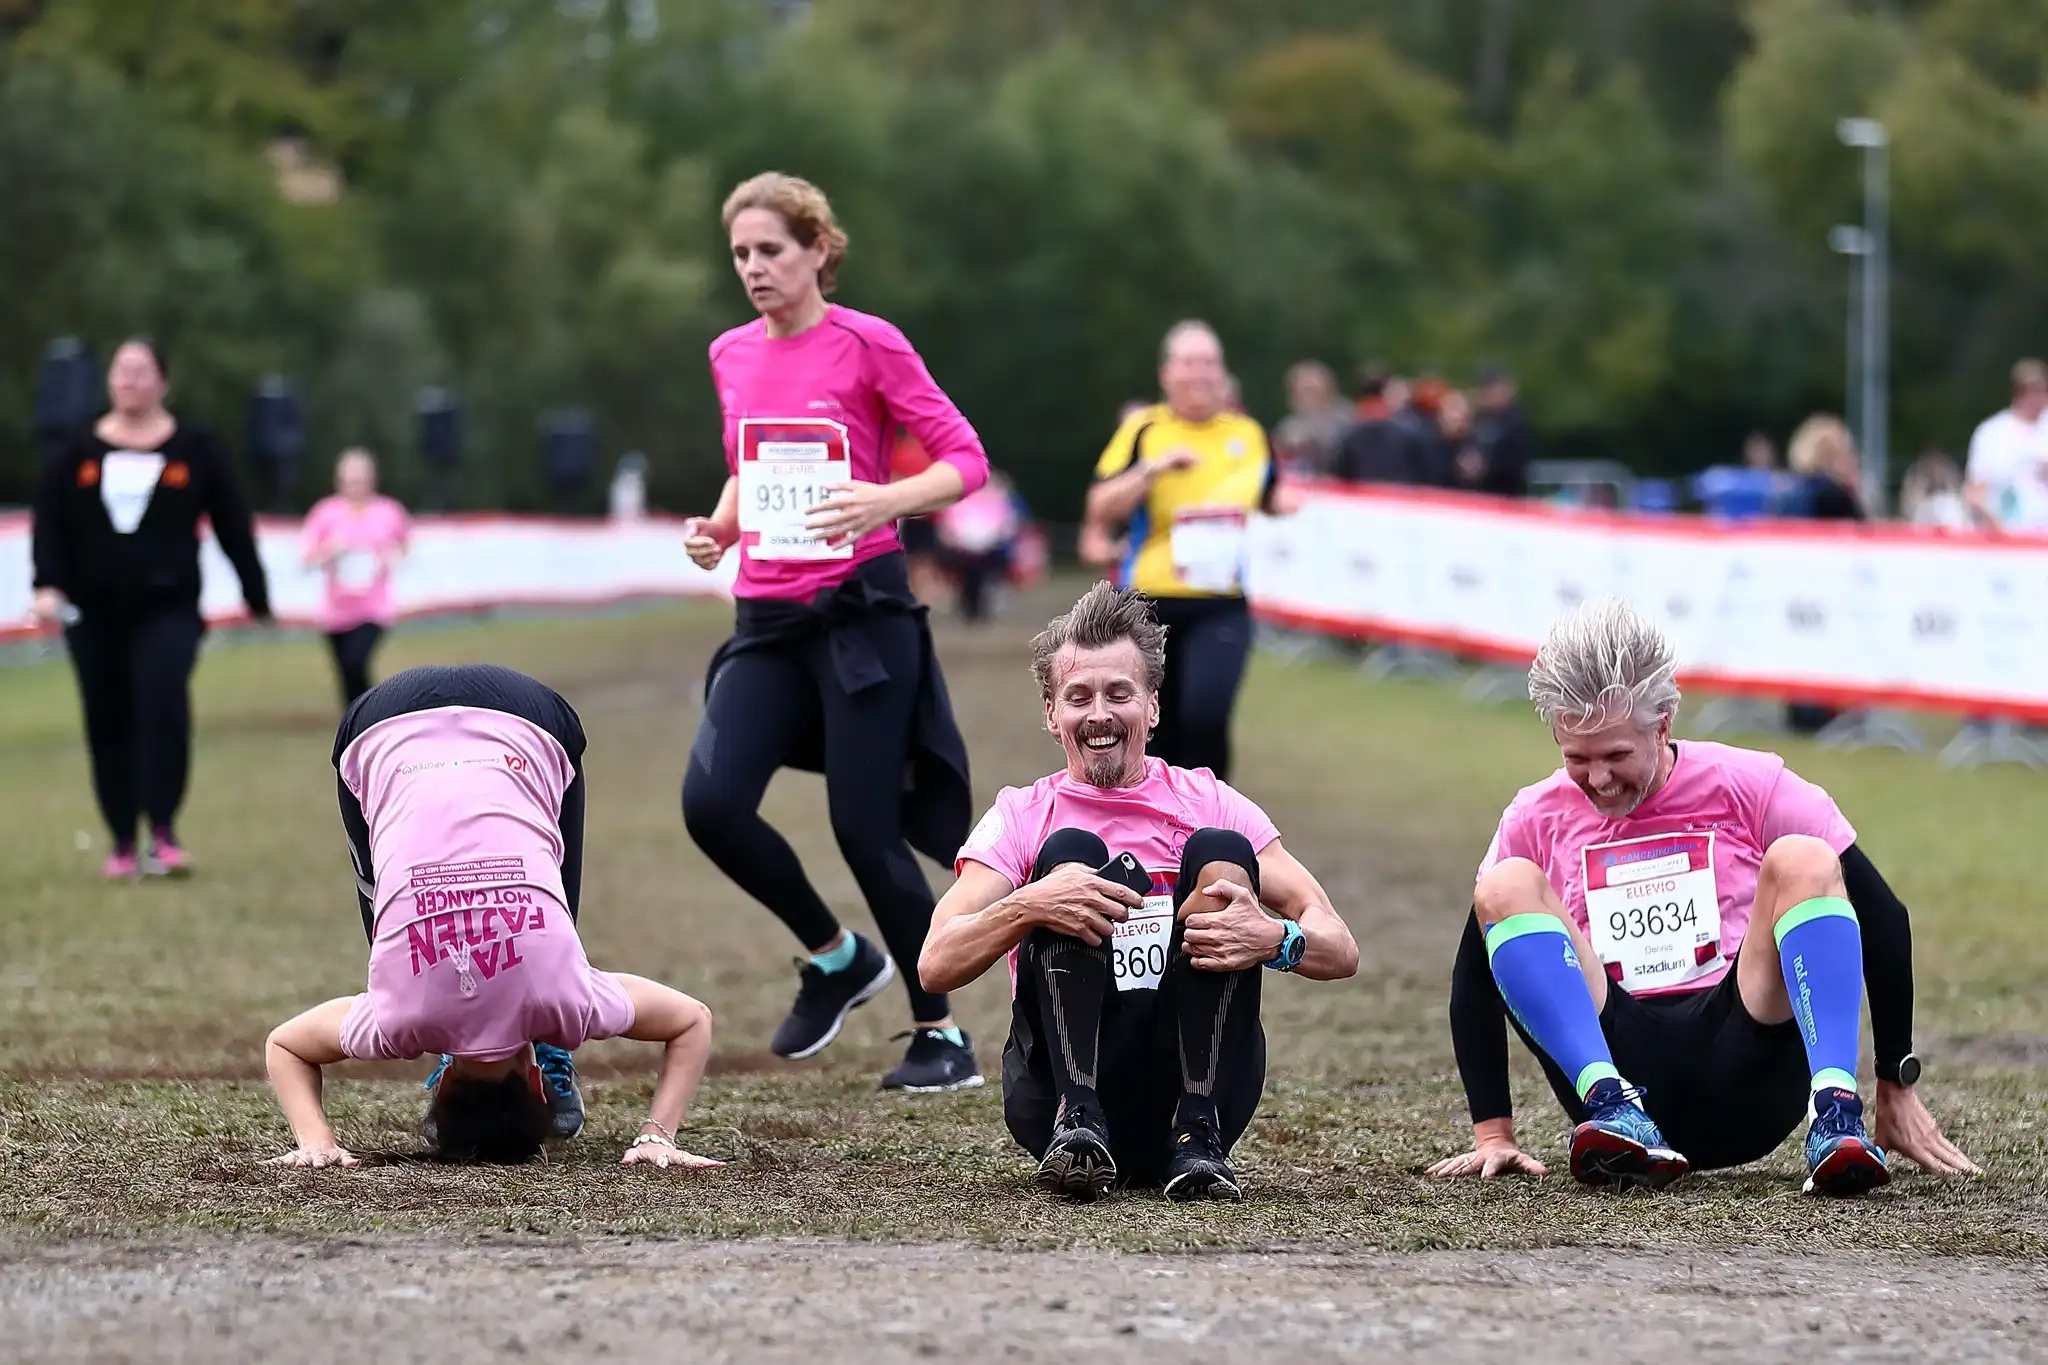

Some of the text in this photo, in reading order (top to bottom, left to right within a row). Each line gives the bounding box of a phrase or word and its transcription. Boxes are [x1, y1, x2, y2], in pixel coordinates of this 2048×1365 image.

[504, 753, 527, 773] ICA
[425, 866, 439, 874] MED
[439, 861, 481, 872] TILLSAMMANS
[412, 879, 425, 887] TILL
[442, 875, 456, 883] OCH
[456, 874, 477, 882] VAROR
[478, 873, 494, 881] ROSA
[1625, 879, 1676, 899] ELLEVIO
[414, 889, 532, 917] MOT CANCER
[1609, 897, 1698, 941] 93634
[1112, 922, 1160, 938] LLEVIO
[406, 906, 547, 977] FAJTEN
[469, 937, 524, 981] TA
[1633, 957, 1686, 976] stadium
[1793, 954, 1808, 983] you
[1799, 981, 1818, 1047] challenge
